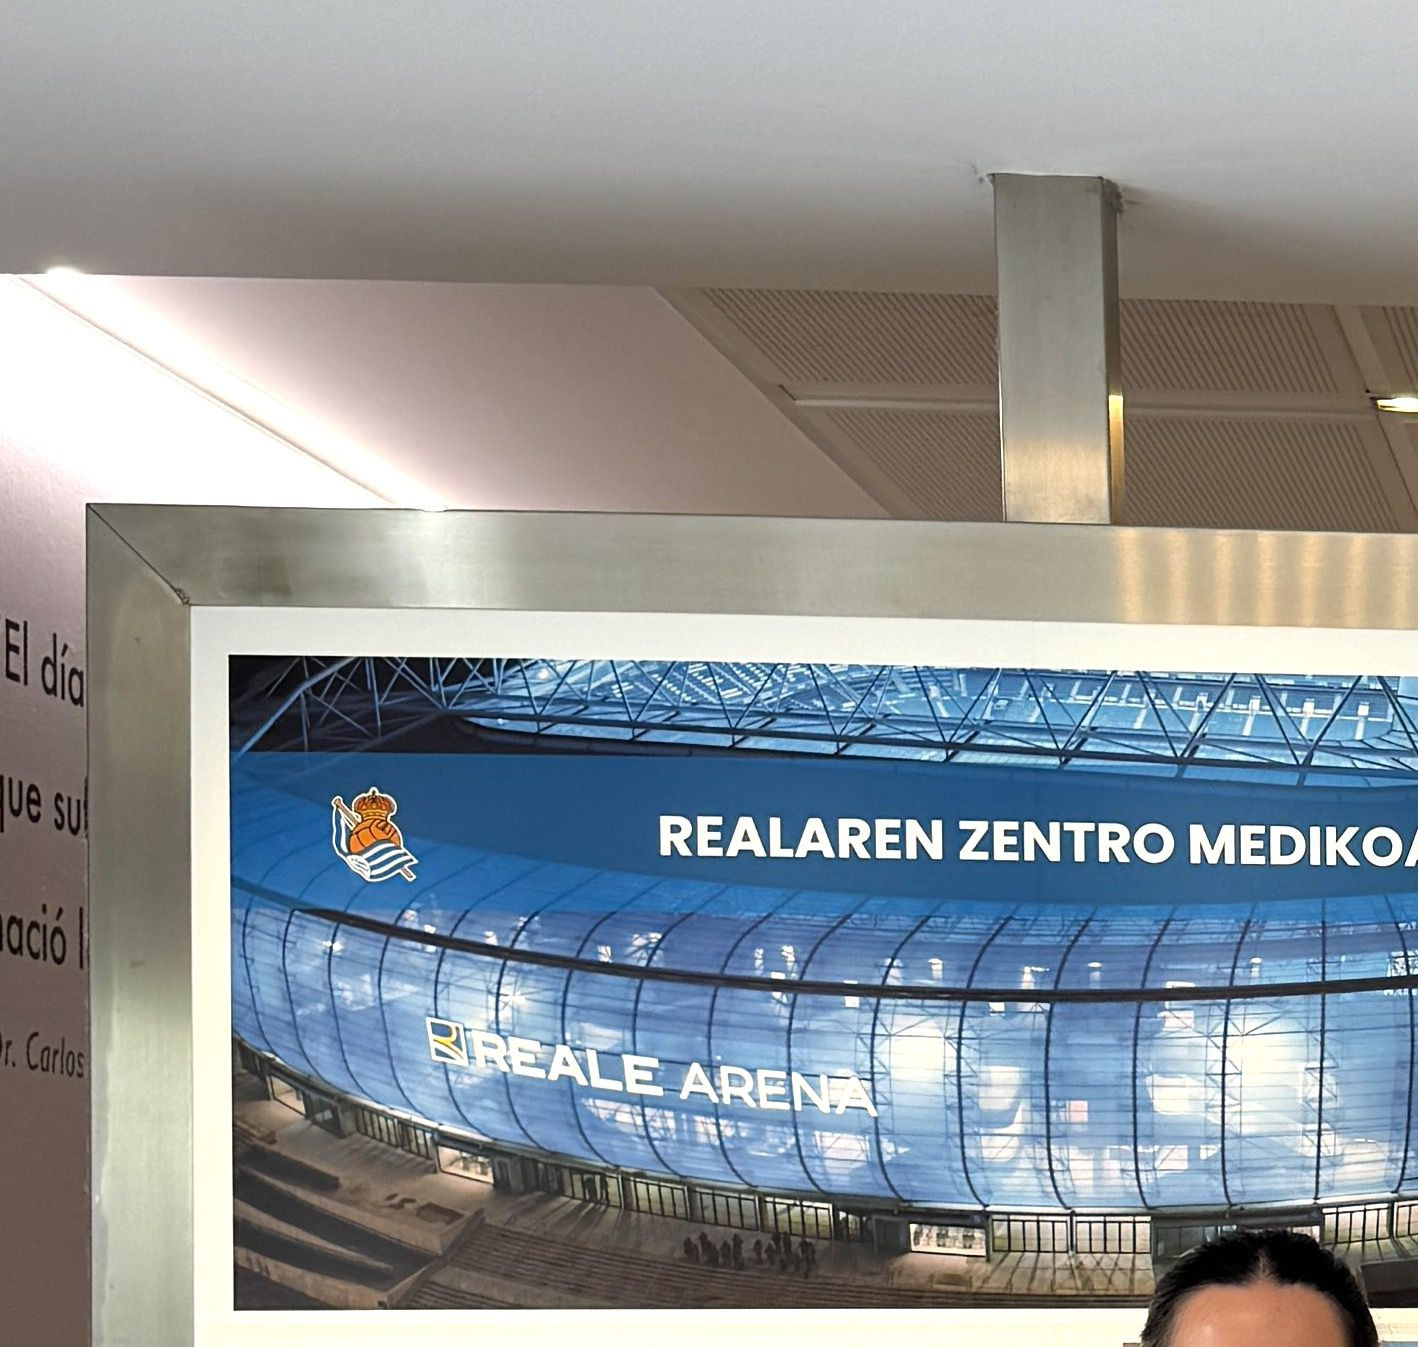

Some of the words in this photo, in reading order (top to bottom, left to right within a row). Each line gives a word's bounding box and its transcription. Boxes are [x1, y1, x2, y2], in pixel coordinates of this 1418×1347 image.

[5, 618, 29, 686] El
[41, 633, 85, 708] día
[0, 774, 42, 834] ue
[54, 776, 88, 838] su
[659, 815, 944, 860] REALAREN
[958, 821, 1175, 864] ZENTRO
[0, 903, 67, 966] ació
[0, 1031, 16, 1068] r.
[27, 1031, 85, 1079] Carlos
[471, 1030, 665, 1097] REALE
[680, 1063, 879, 1118] ARENA
